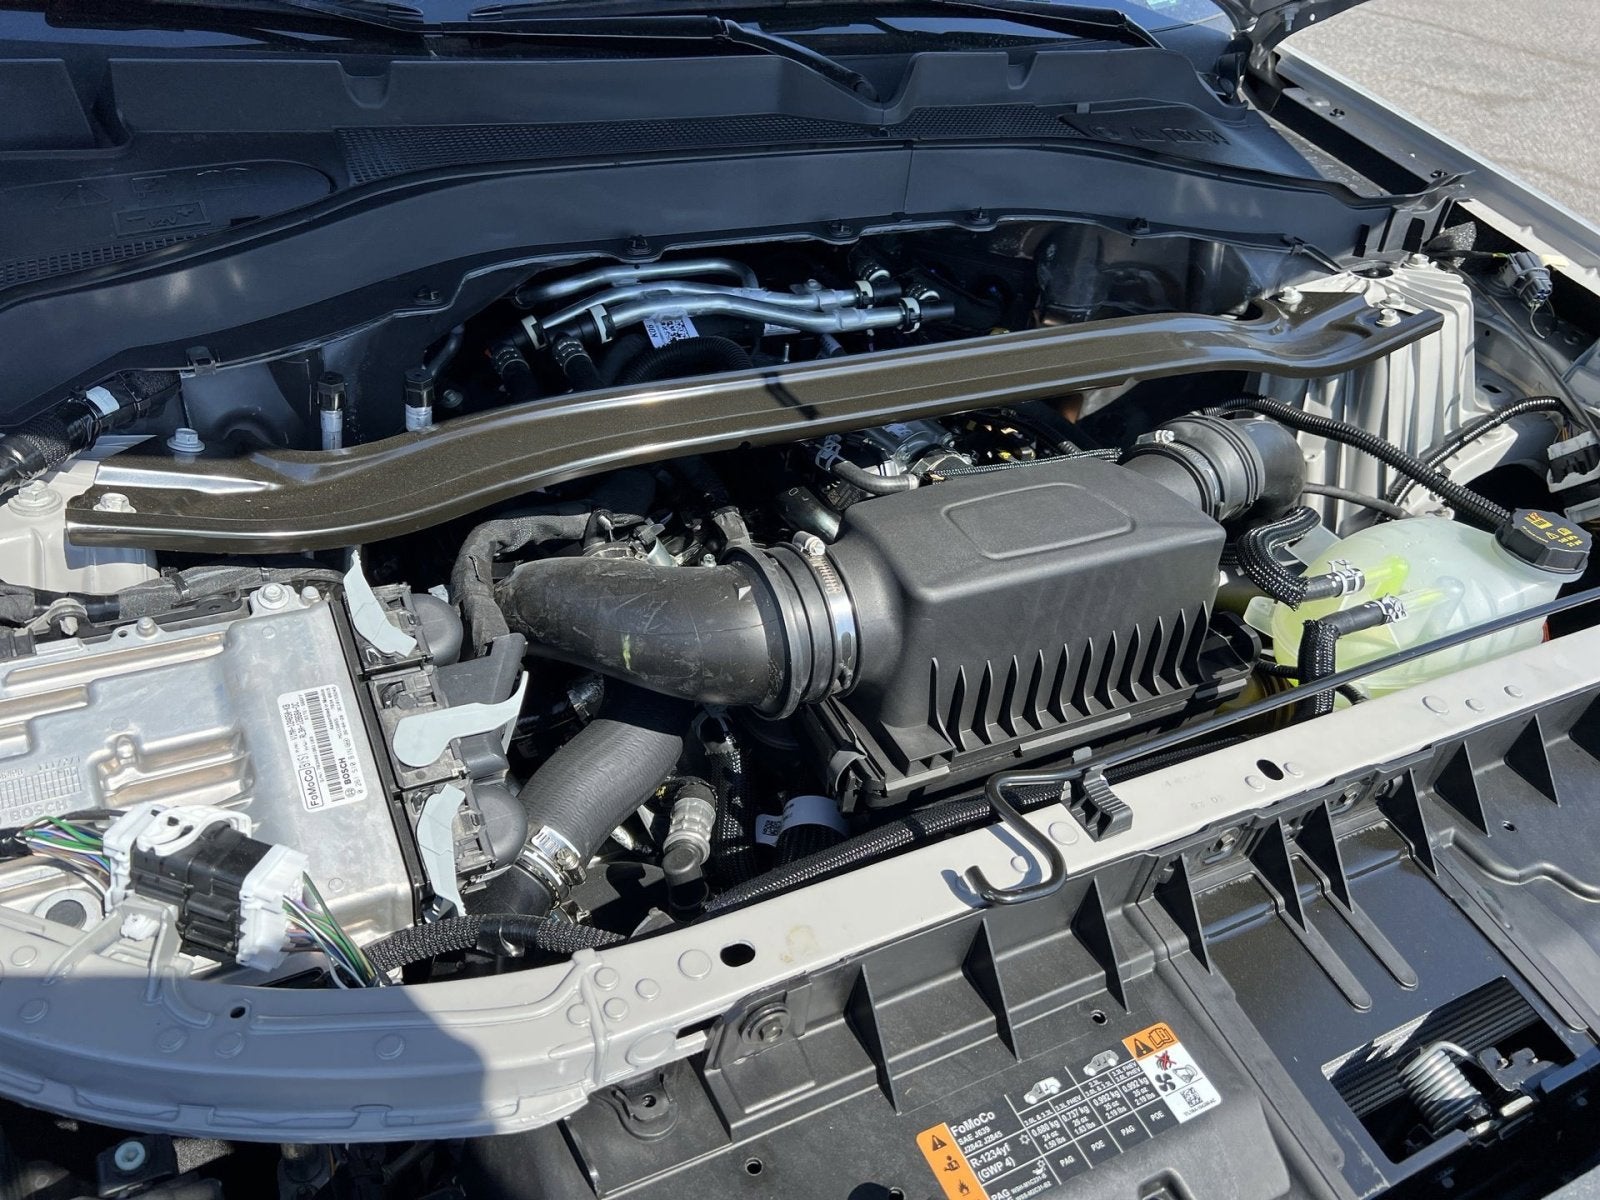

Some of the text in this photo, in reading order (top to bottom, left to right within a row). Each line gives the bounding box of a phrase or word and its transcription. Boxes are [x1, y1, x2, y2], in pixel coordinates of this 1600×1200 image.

[338, 757, 352, 785] BOSCH
[303, 769, 319, 806] FoMoCo
[10, 802, 67, 820] BOSCH
[1138, 1077, 1149, 1085] kg
[1109, 1090, 1121, 1098] kg
[1134, 1092, 1156, 1105] 2.19 lbs
[1061, 1106, 1090, 1122] 0.737 kg
[1105, 1106, 1127, 1119] 2.19 lbs
[1150, 1111, 1164, 1121] POE
[950, 1112, 995, 1137] FoMoCo
[1048, 1120, 1061, 1128] kg
[1120, 1125, 1135, 1136] PAG
[958, 1126, 991, 1145] SAE J639
[964, 1131, 1003, 1154] J2842 J2845
[1044, 1136, 1066, 1150] 1.50 lbs
[1091, 1140, 1105, 1151] POE
[970, 1142, 1010, 1168] R-1234yf
[1059, 1155, 1075, 1167] PAG
[978, 1156, 1016, 1182] (GWP 4)
